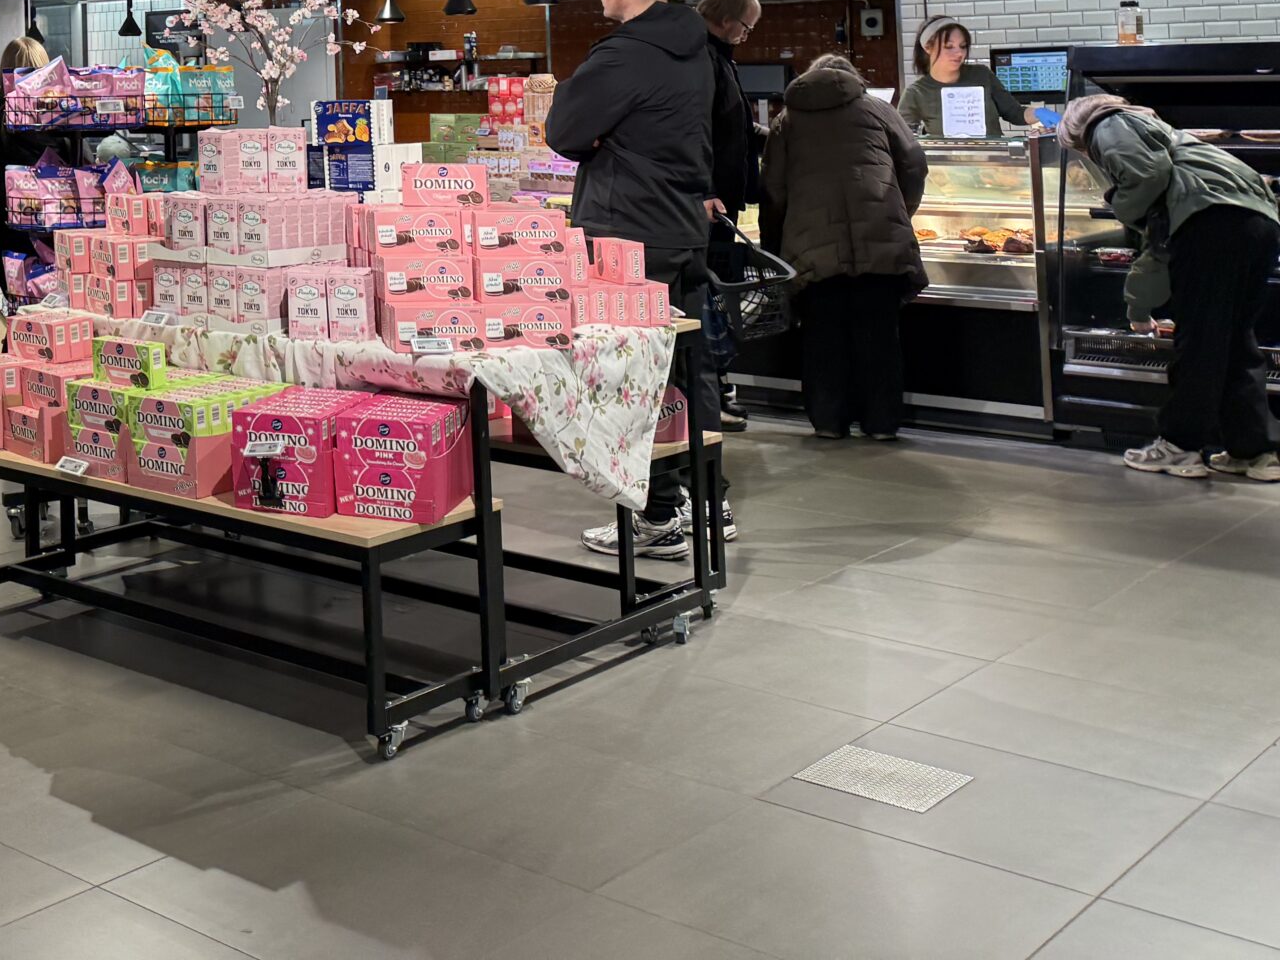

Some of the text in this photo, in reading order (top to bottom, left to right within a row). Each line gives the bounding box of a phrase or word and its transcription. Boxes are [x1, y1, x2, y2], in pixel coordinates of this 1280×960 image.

[325, 102, 366, 115] JAFFA
[203, 164, 218, 172] TOKYO
[241, 160, 261, 168] TOKYO
[276, 160, 296, 168] TOKYO
[413, 178, 474, 190] DOMINO
[108, 206, 127, 219] DOMINO
[178, 229, 193, 238] TOKYO
[213, 231, 230, 239] TOKYO
[244, 232, 261, 241] TOKYO
[411, 228, 452, 237] DOMINO
[513, 230, 557, 238] DOMINO
[92, 249, 112, 264] DOMINO
[422, 275, 464, 283] DOMINO
[518, 277, 562, 285] DOMINO
[87, 288, 110, 302] DOMINO
[160, 293, 174, 301] TOKYO
[187, 295, 202, 303] TOKYO
[214, 298, 230, 306] TOKYO
[244, 302, 260, 311] TOKYO
[297, 307, 318, 316] TOKYO
[337, 307, 358, 316] TOKYO
[433, 326, 477, 334] DOMINO
[519, 322, 562, 330] DOMINO
[13, 331, 48, 346] DOMINO
[100, 353, 143, 371] DOMINO
[27, 381, 56, 398] DOMINO
[74, 398, 118, 417] DOMINO
[659, 400, 685, 420] INO
[137, 411, 185, 429] DOMINO
[248, 431, 308, 447] DOMINO
[353, 436, 417, 453] DOMINO
[375, 451, 395, 460] PINK
[252, 479, 309, 495] DINO
[340, 494, 354, 504] NEW
[253, 496, 307, 513] INO
[356, 503, 413, 519] DOMINO
